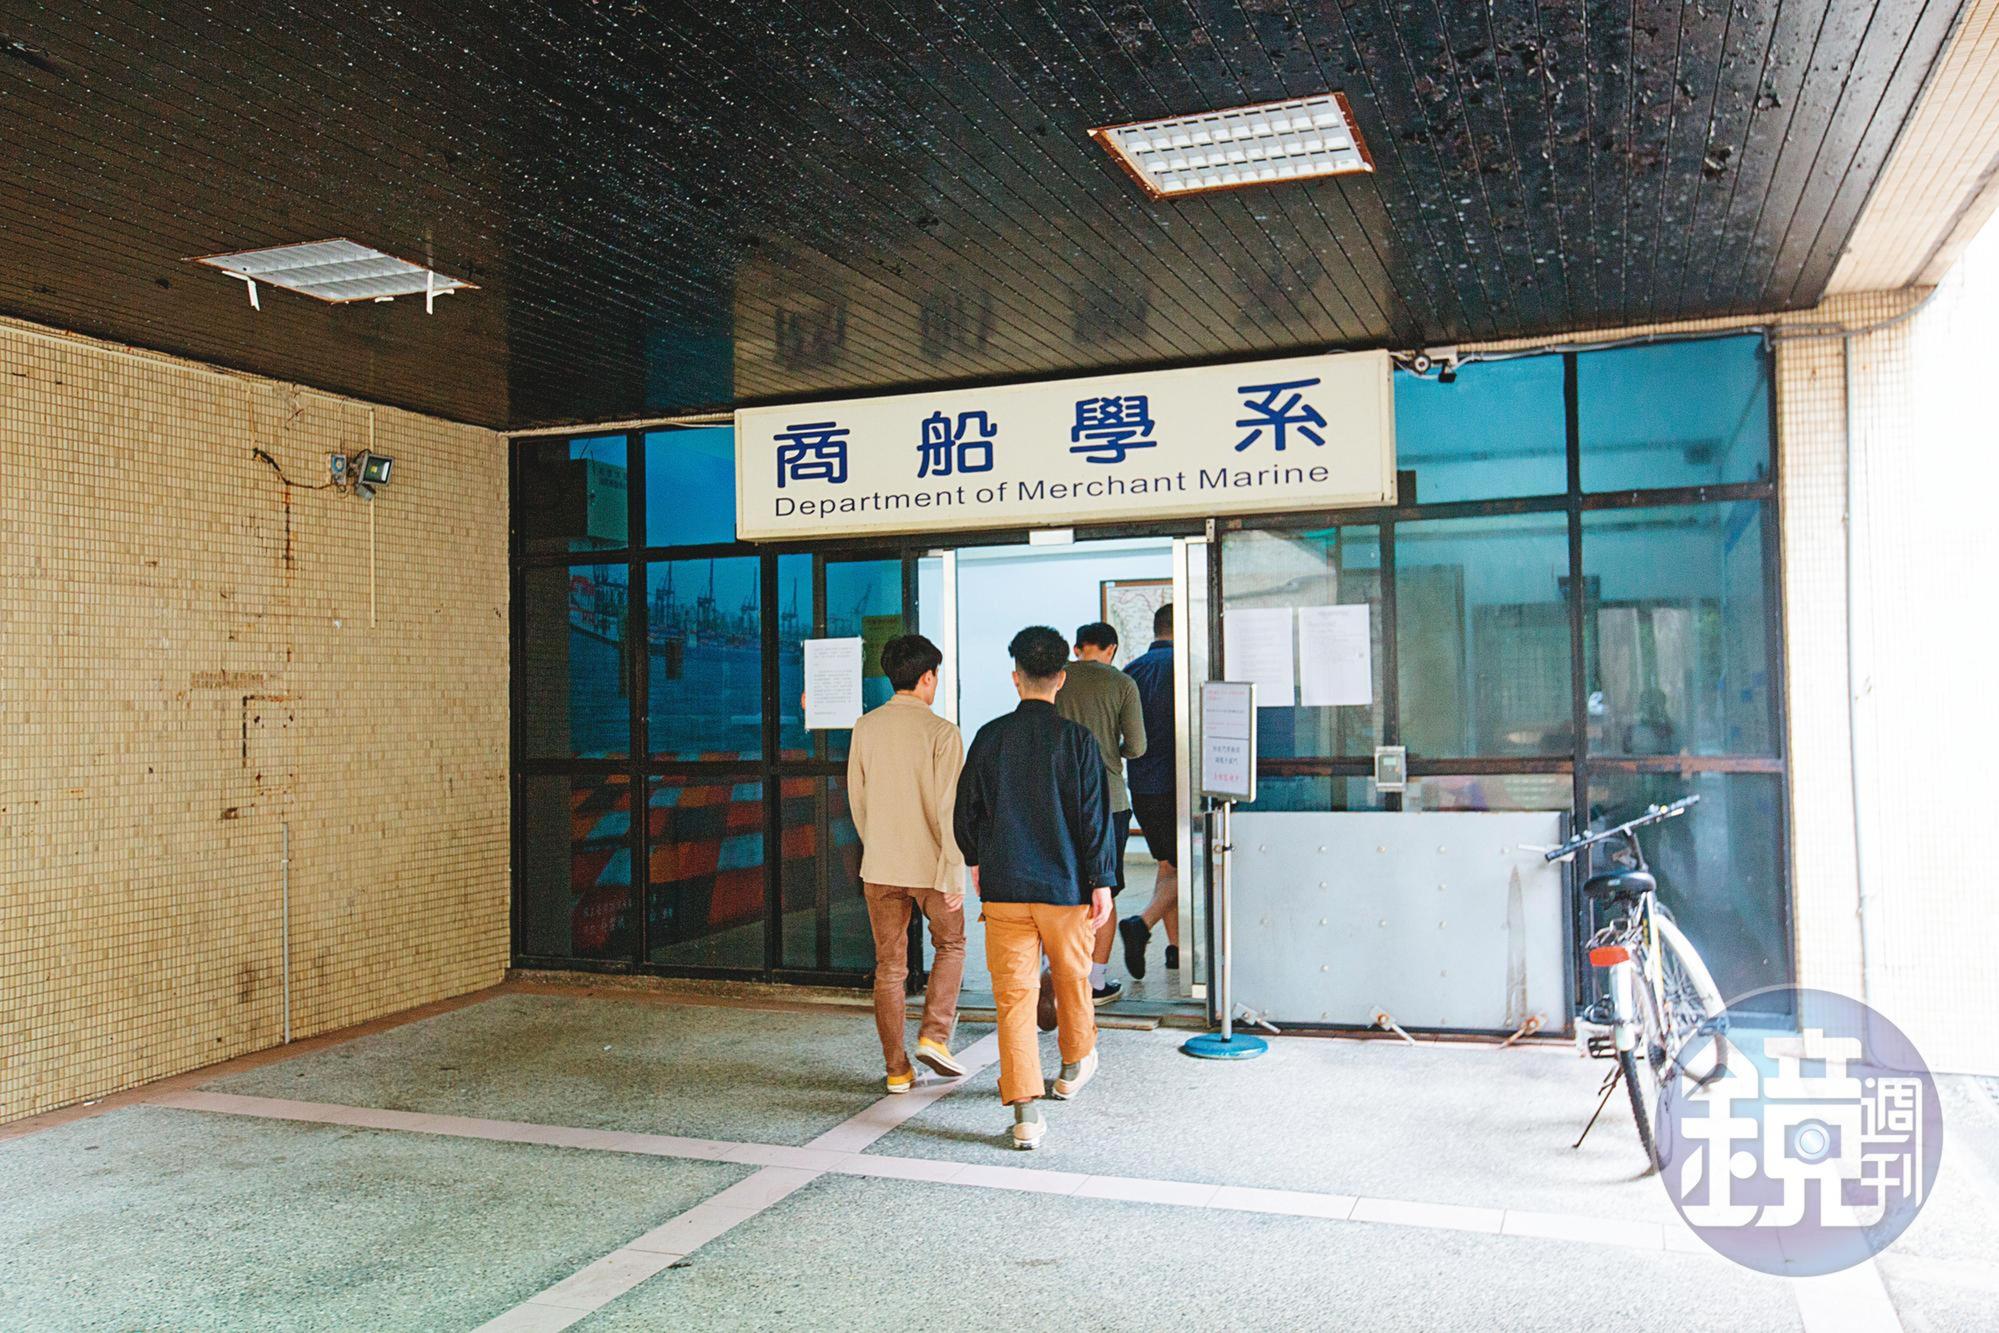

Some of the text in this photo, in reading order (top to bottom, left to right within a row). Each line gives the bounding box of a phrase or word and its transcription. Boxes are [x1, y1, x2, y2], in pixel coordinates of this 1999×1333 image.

[773, 377, 1328, 488] 商船學系
[775, 464, 1330, 518] Department of Merchant Marine
